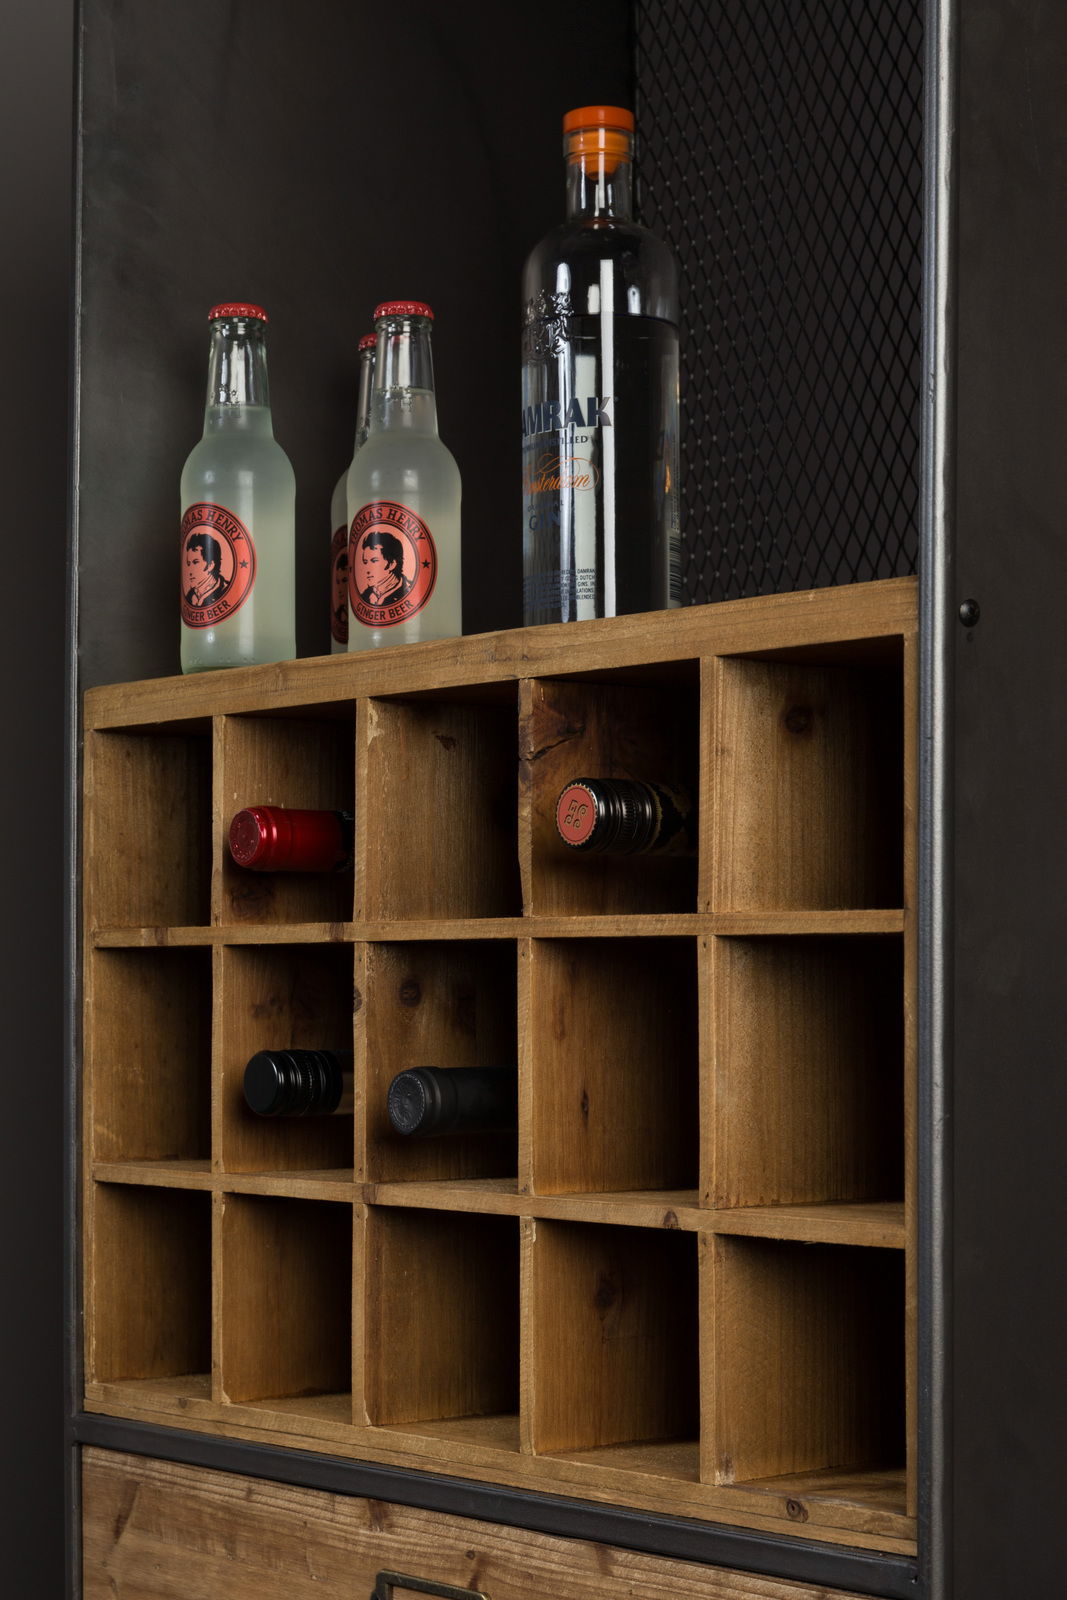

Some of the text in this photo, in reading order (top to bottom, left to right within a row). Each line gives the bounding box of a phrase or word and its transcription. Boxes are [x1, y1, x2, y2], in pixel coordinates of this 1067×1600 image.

[522, 396, 613, 438] AMRAK
[206, 509, 244, 542] HENRY
[350, 507, 383, 545] THOMAS
[386, 508, 426, 541] HENRY
[207, 600, 231, 620] BEER
[355, 600, 414, 621] GINGER BEER
